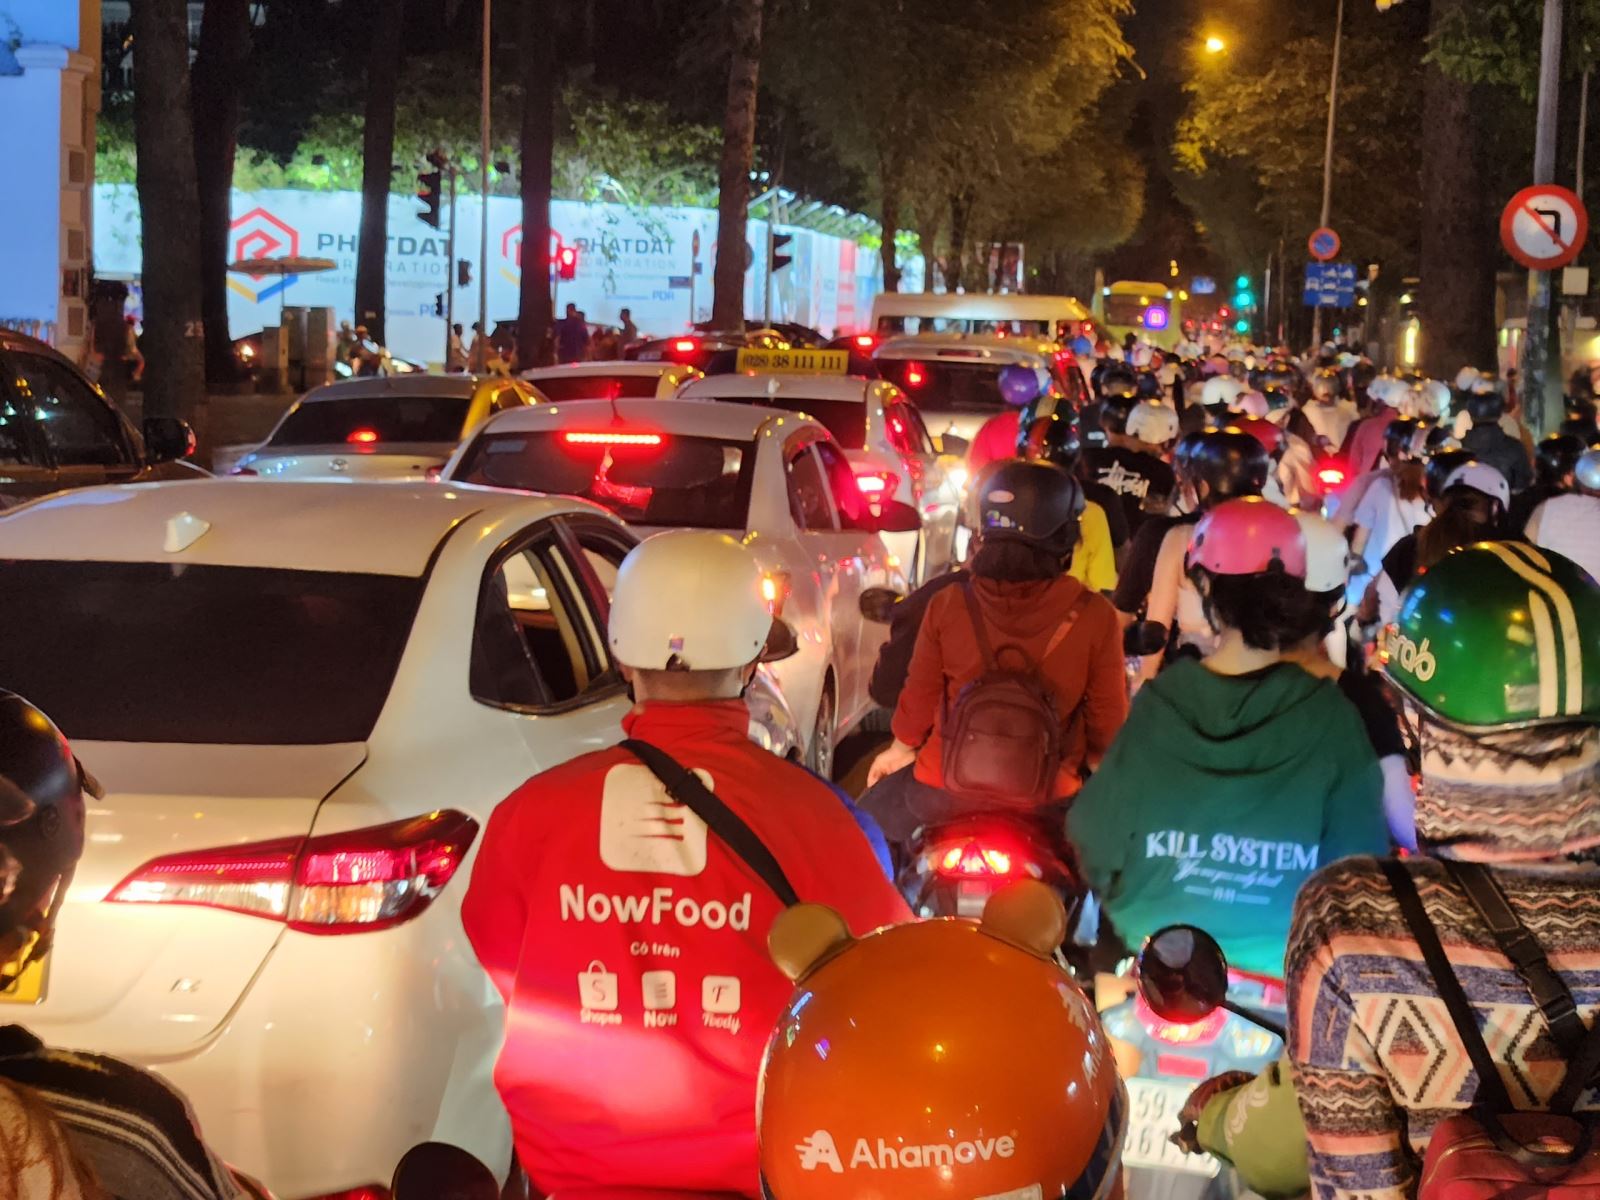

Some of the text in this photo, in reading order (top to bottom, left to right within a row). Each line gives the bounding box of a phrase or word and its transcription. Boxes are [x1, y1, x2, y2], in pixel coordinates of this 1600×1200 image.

[317, 233, 449, 256] PHDAT
[576, 238, 673, 254] PHATDAT
[772, 355, 790, 368] 38
[794, 355, 814, 368] 111
[821, 356, 841, 369] 111
[1145, 830, 1319, 871] KILL SYSTEM
[559, 883, 752, 931] NowFood
[630, 941, 680, 958] Có trên
[643, 1010, 677, 1028] Now
[849, 1135, 1015, 1169] Ahamove
